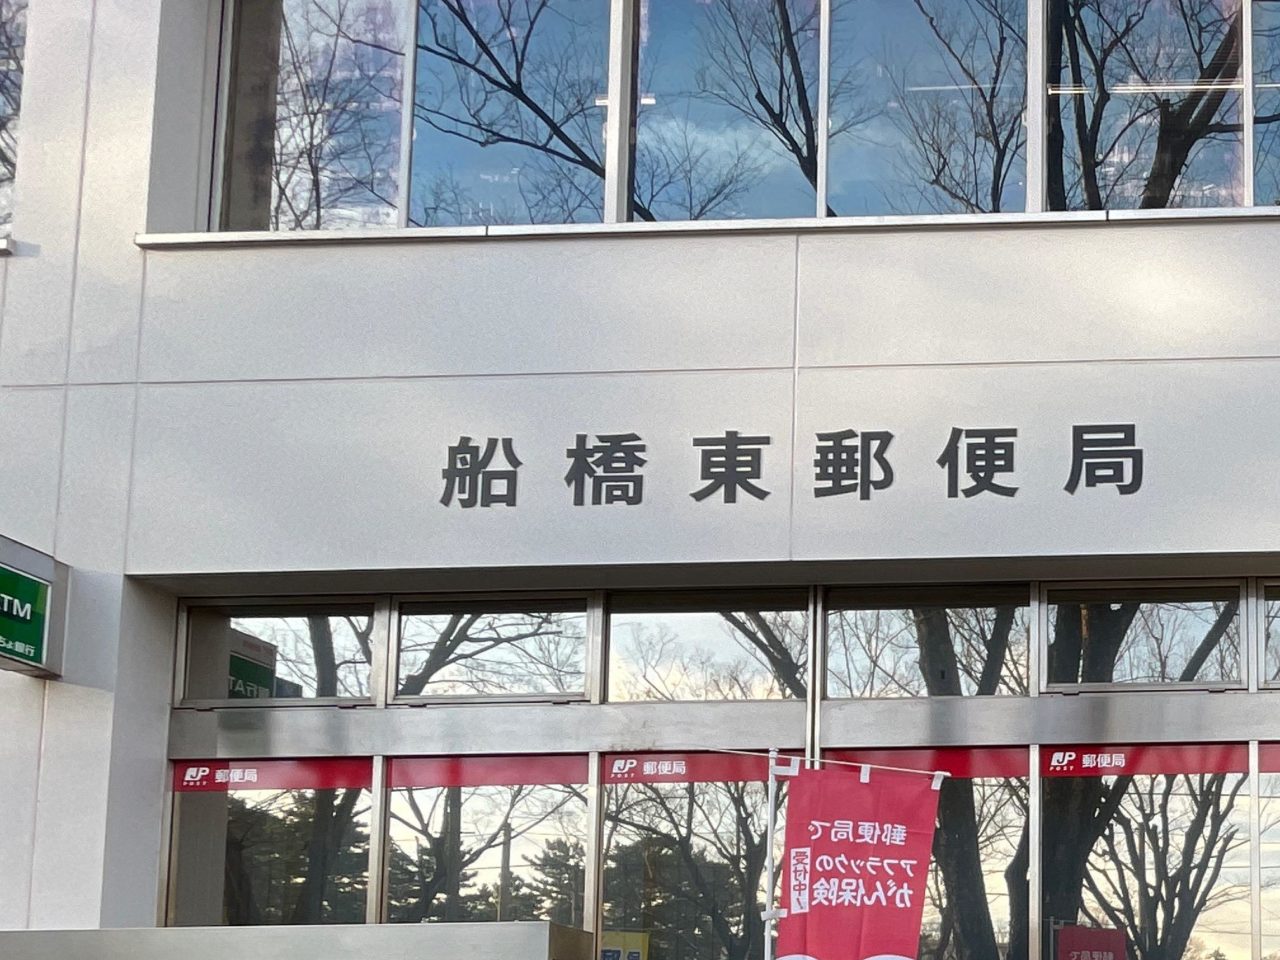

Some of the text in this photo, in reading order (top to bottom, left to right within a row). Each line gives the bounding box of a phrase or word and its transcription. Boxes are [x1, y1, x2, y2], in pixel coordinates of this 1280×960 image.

[439, 425, 1145, 508] 船橋東郵便局
[0, 593, 32, 620] TM
[643, 761, 686, 775] 郵便局
[1082, 754, 1125, 768] 郵便局
[215, 769, 258, 783] 郵便局
